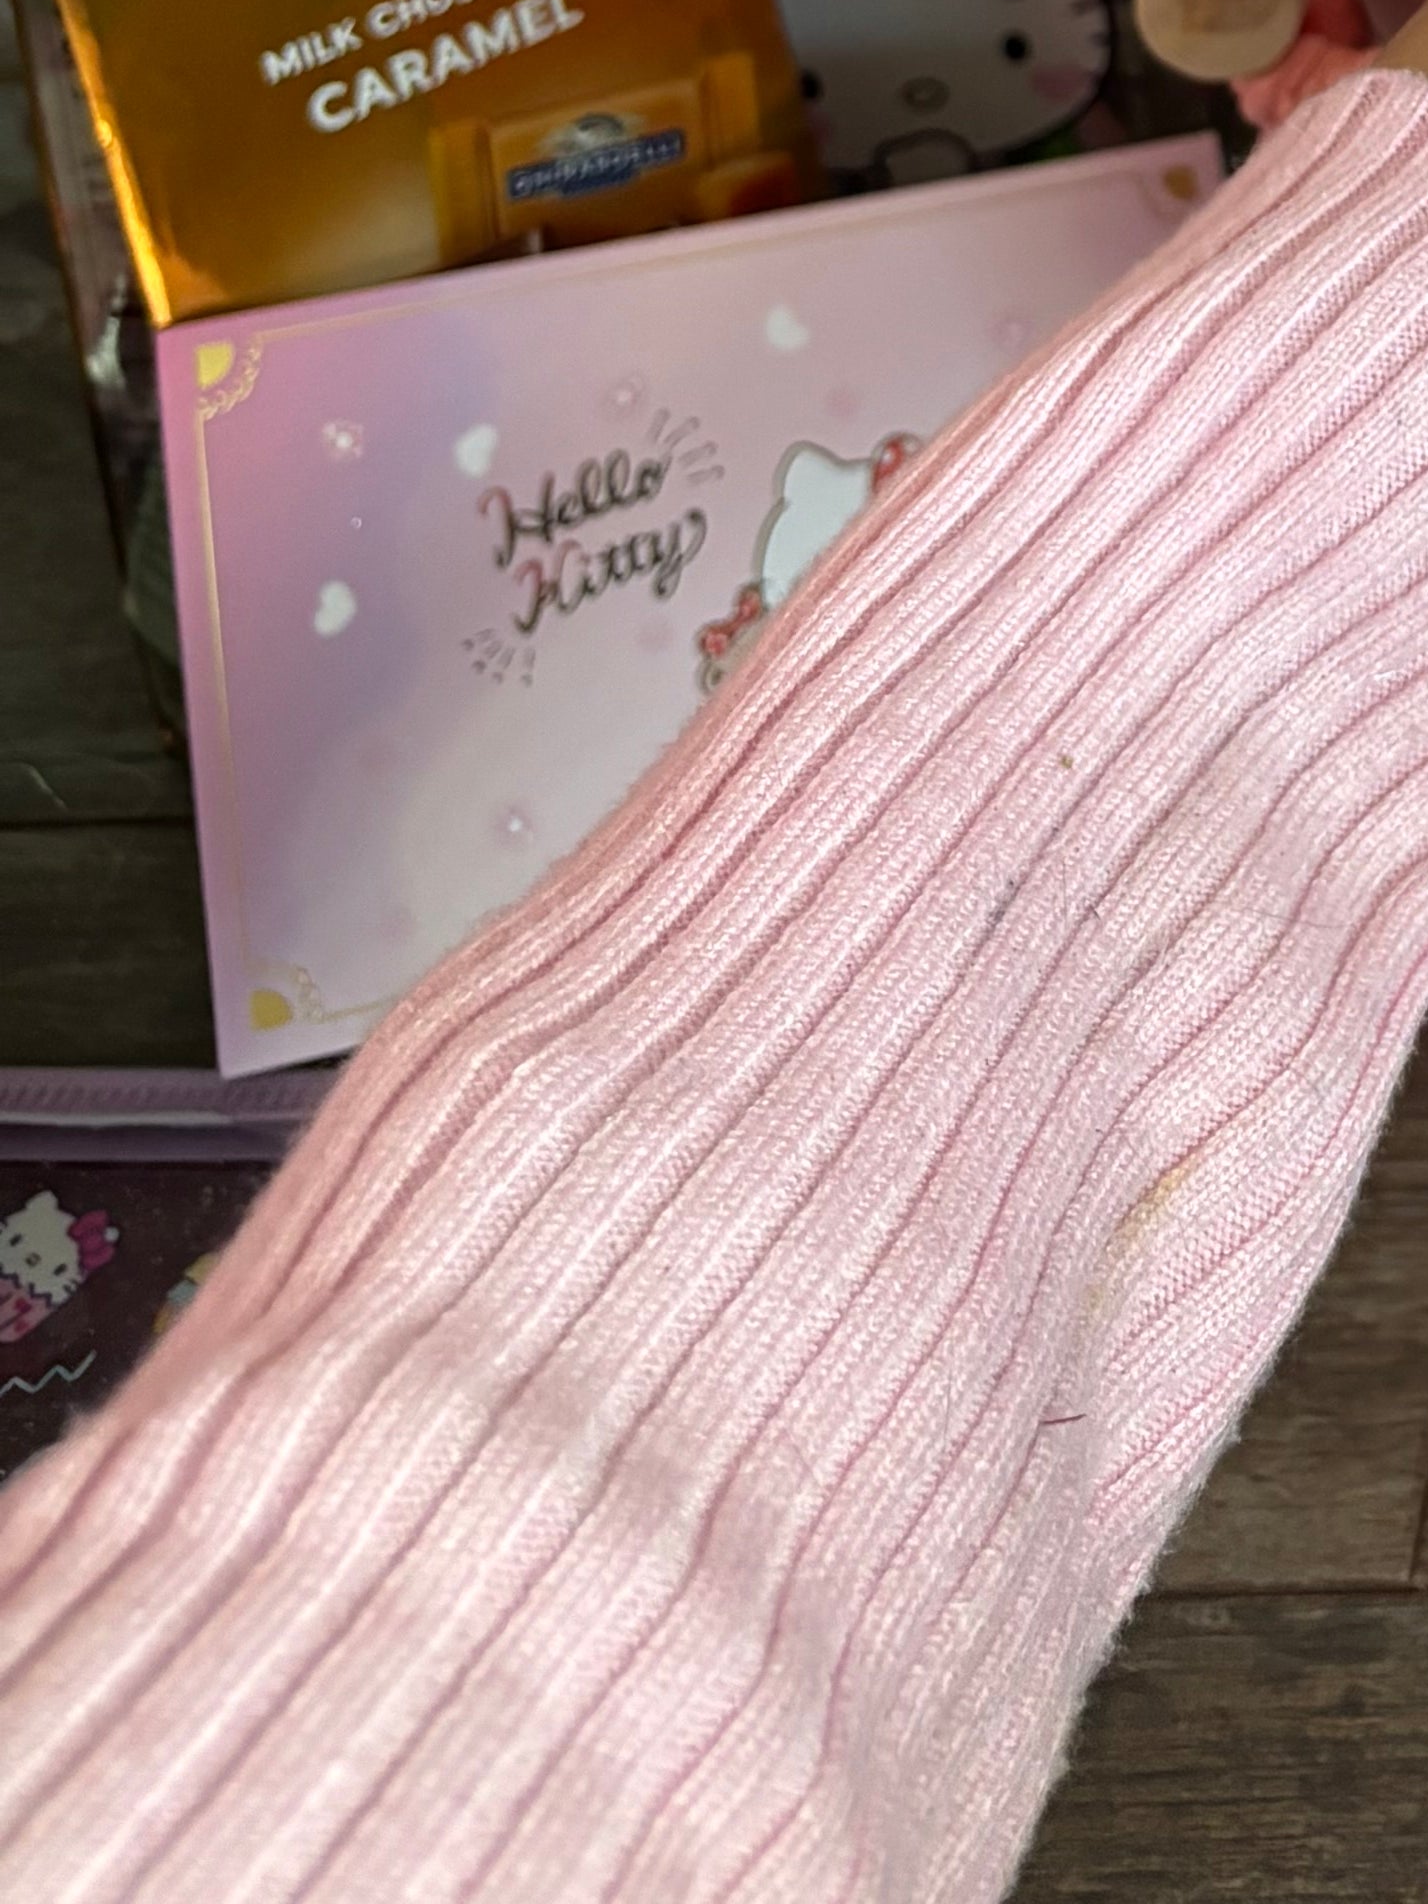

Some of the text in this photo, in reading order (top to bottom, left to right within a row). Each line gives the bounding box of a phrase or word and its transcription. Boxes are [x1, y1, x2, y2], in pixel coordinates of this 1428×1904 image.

[260, 16, 364, 86] MILK
[477, 448, 673, 570] Hello
[513, 506, 708, 635] Kitty
